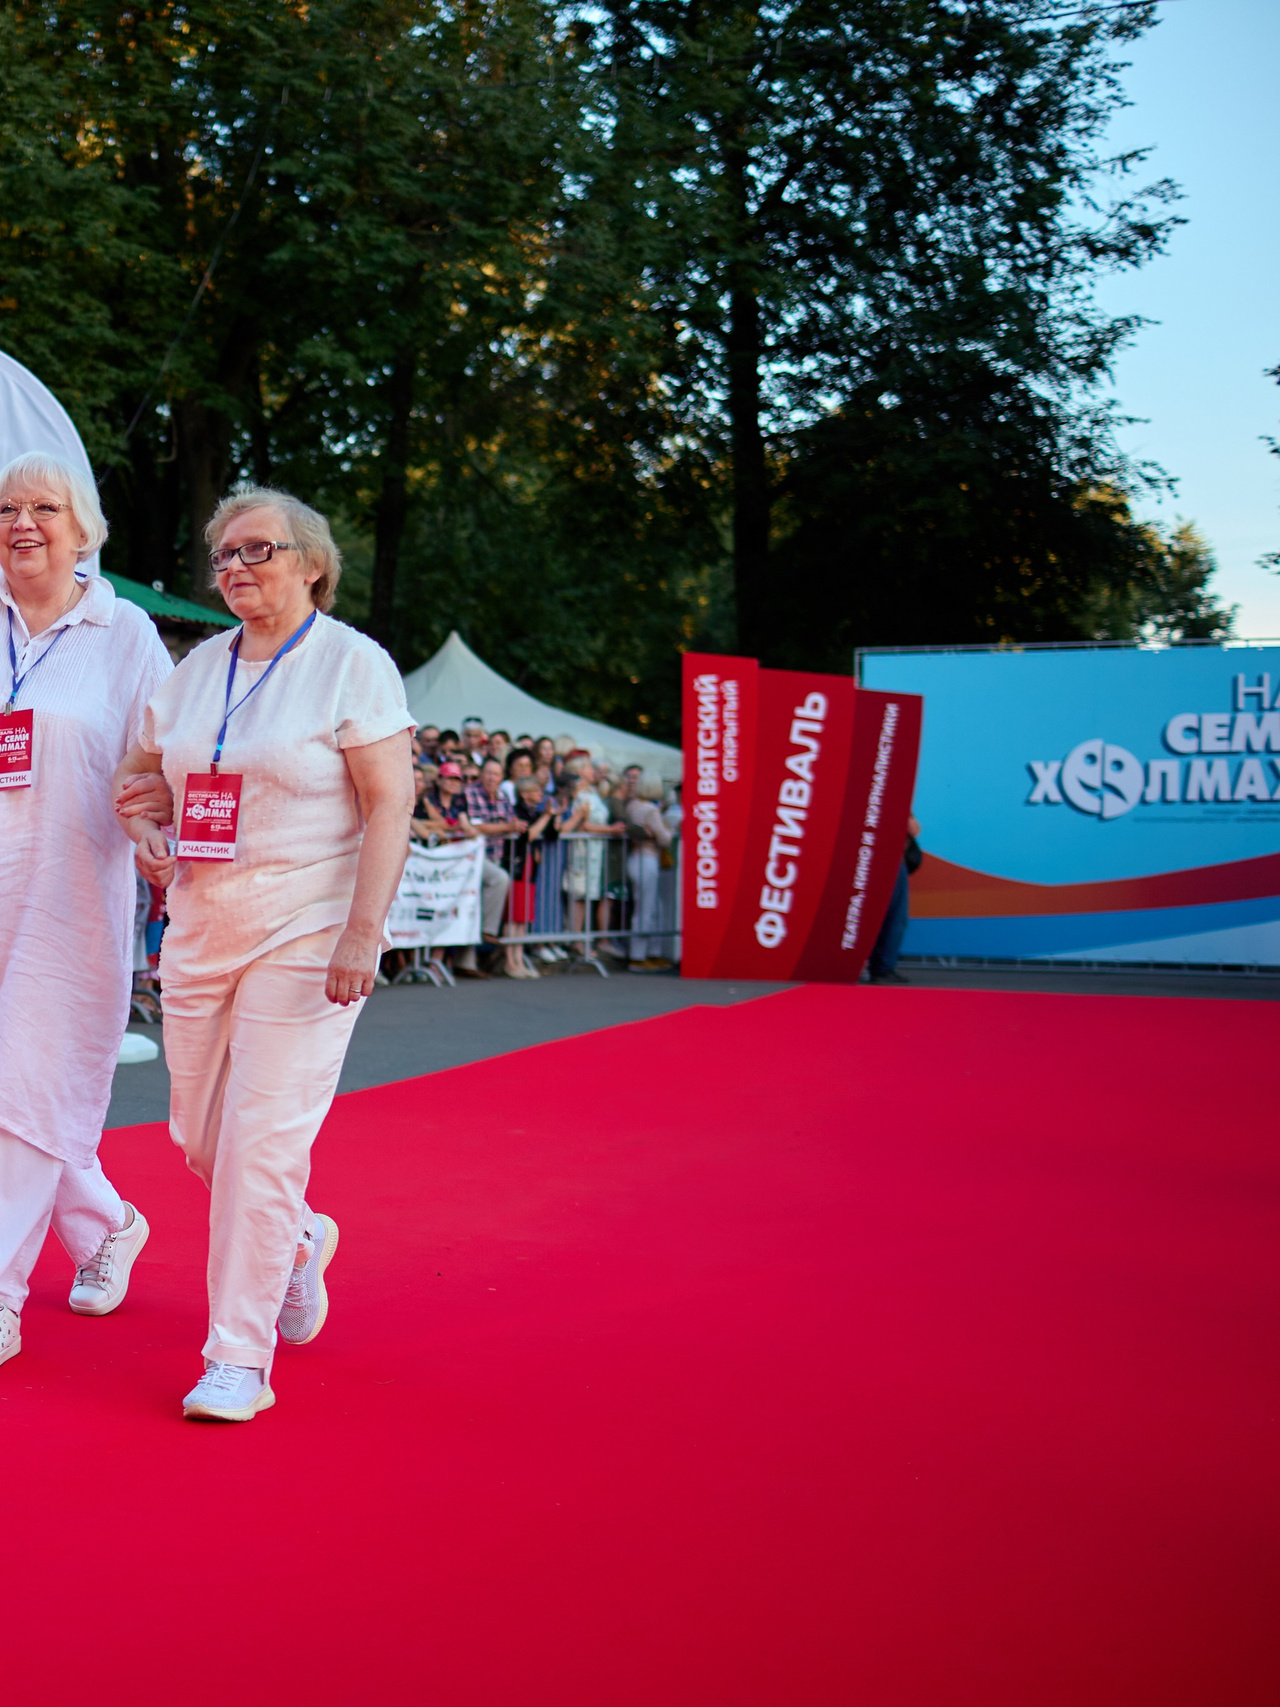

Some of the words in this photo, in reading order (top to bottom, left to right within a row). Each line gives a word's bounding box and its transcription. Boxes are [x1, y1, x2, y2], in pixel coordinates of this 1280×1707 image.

[5, 733, 29, 743] СЕМИ
[15, 727, 27, 735] НА
[693, 674, 719, 796] ВЯТСКИЙ
[719, 679, 739, 782] ОТКРЫТЫЙ
[209, 799, 236, 809] СЕМИ
[221, 792, 233, 800] НА
[854, 846, 873, 890] КИНО
[864, 702, 900, 828] ЖУРНАЛИСТИКИ
[186, 803, 232, 820] ХОЛМАХ
[755, 691, 829, 948] ФЕСТИВАЛЬ
[182, 845, 230, 855] УЧАСТНИК
[693, 800, 719, 909] ВТОРОЙ
